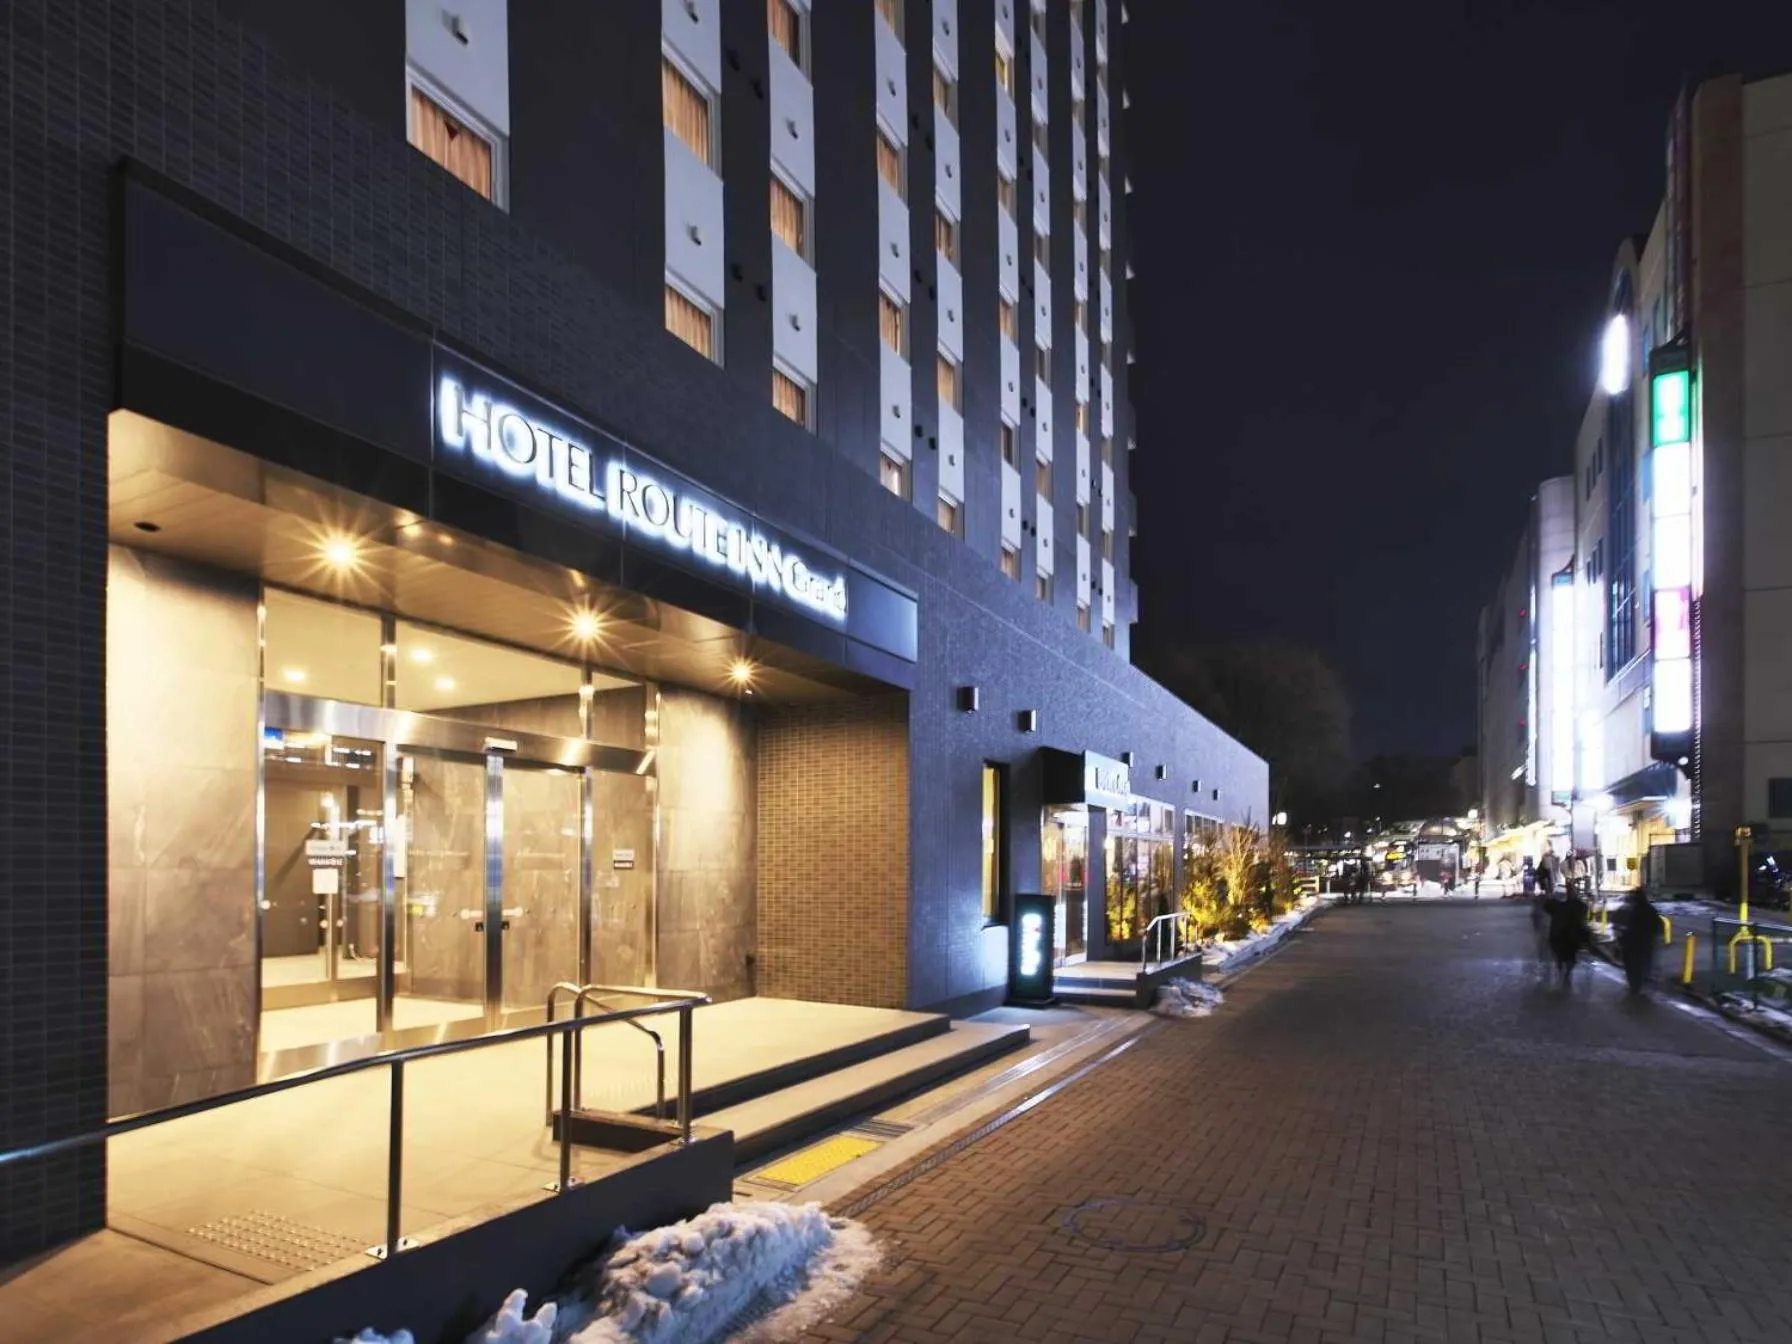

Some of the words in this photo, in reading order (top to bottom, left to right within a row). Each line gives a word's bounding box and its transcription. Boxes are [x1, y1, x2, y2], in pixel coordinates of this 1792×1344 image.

[441, 376, 606, 506] HOTEL
[612, 463, 728, 563] ROUTE
[731, 524, 784, 591] INN
